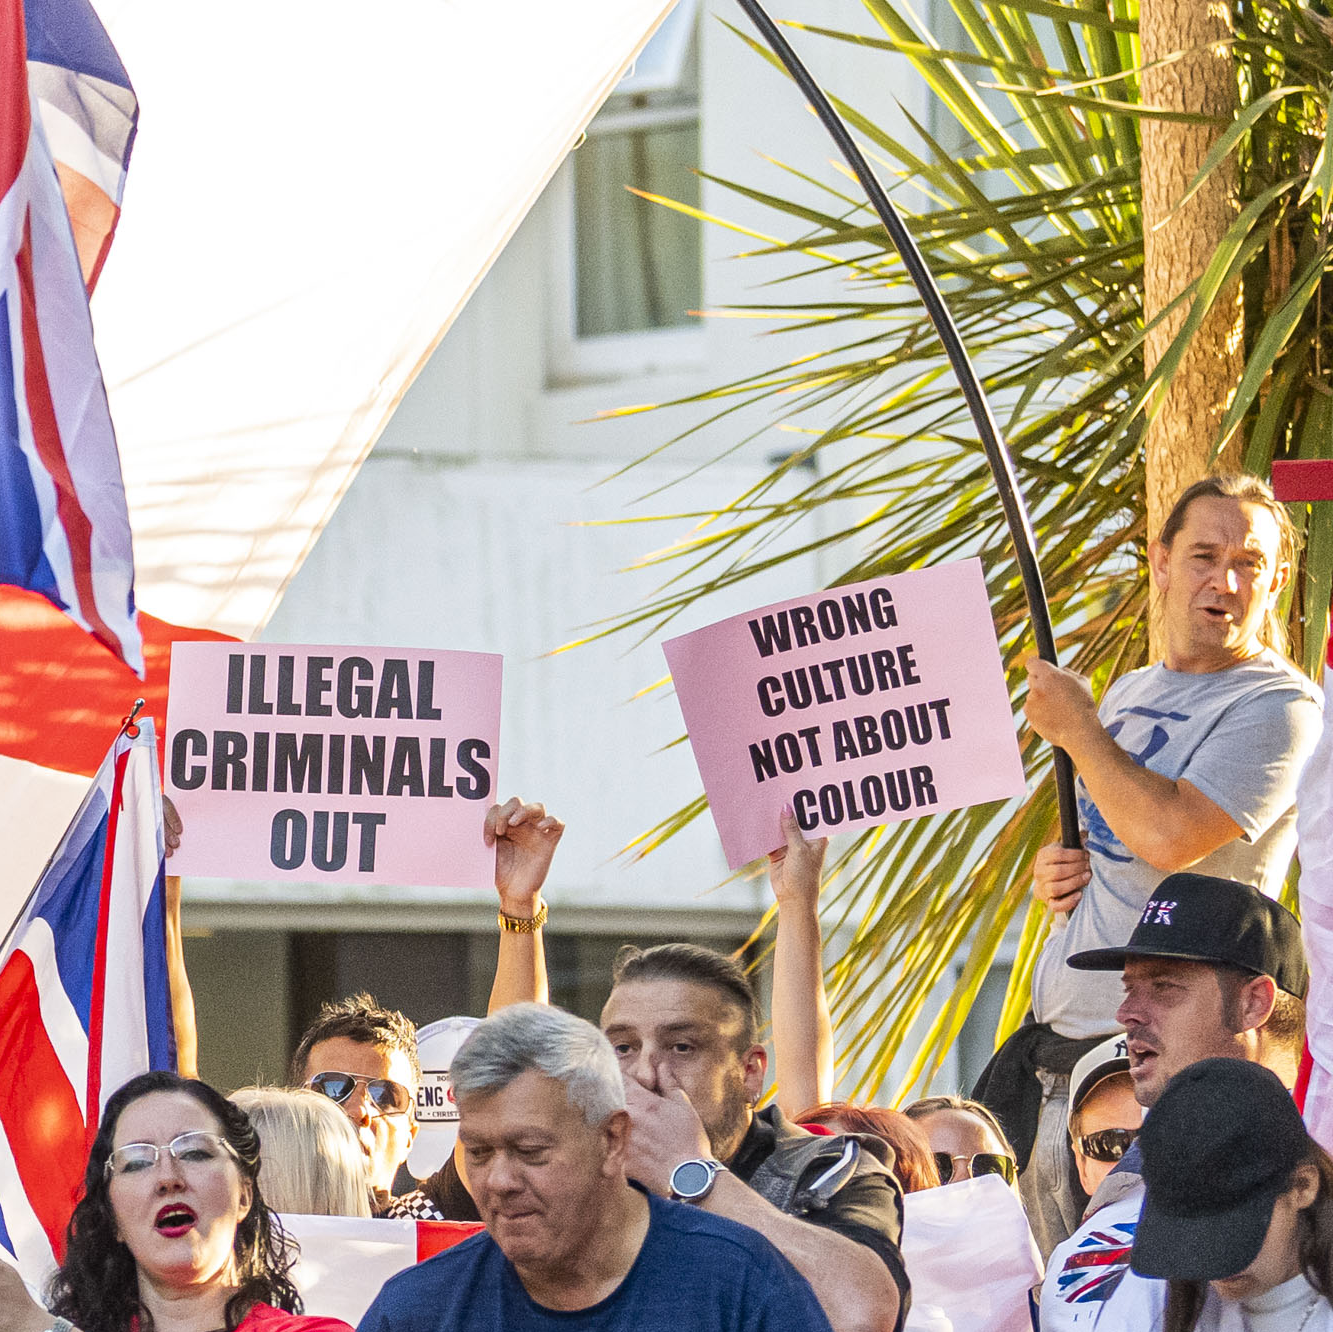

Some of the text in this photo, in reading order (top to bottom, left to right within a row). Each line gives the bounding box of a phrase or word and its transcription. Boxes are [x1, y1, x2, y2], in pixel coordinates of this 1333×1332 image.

[747, 587, 899, 658] WRONG
[226, 653, 442, 721] ILLEGAL
[756, 643, 922, 718] CULTURE
[170, 728, 491, 801] CRIMINALS
[747, 697, 952, 784] NOT ABOUT
[793, 764, 939, 832] COLOUR
[269, 808, 387, 873] OUT
